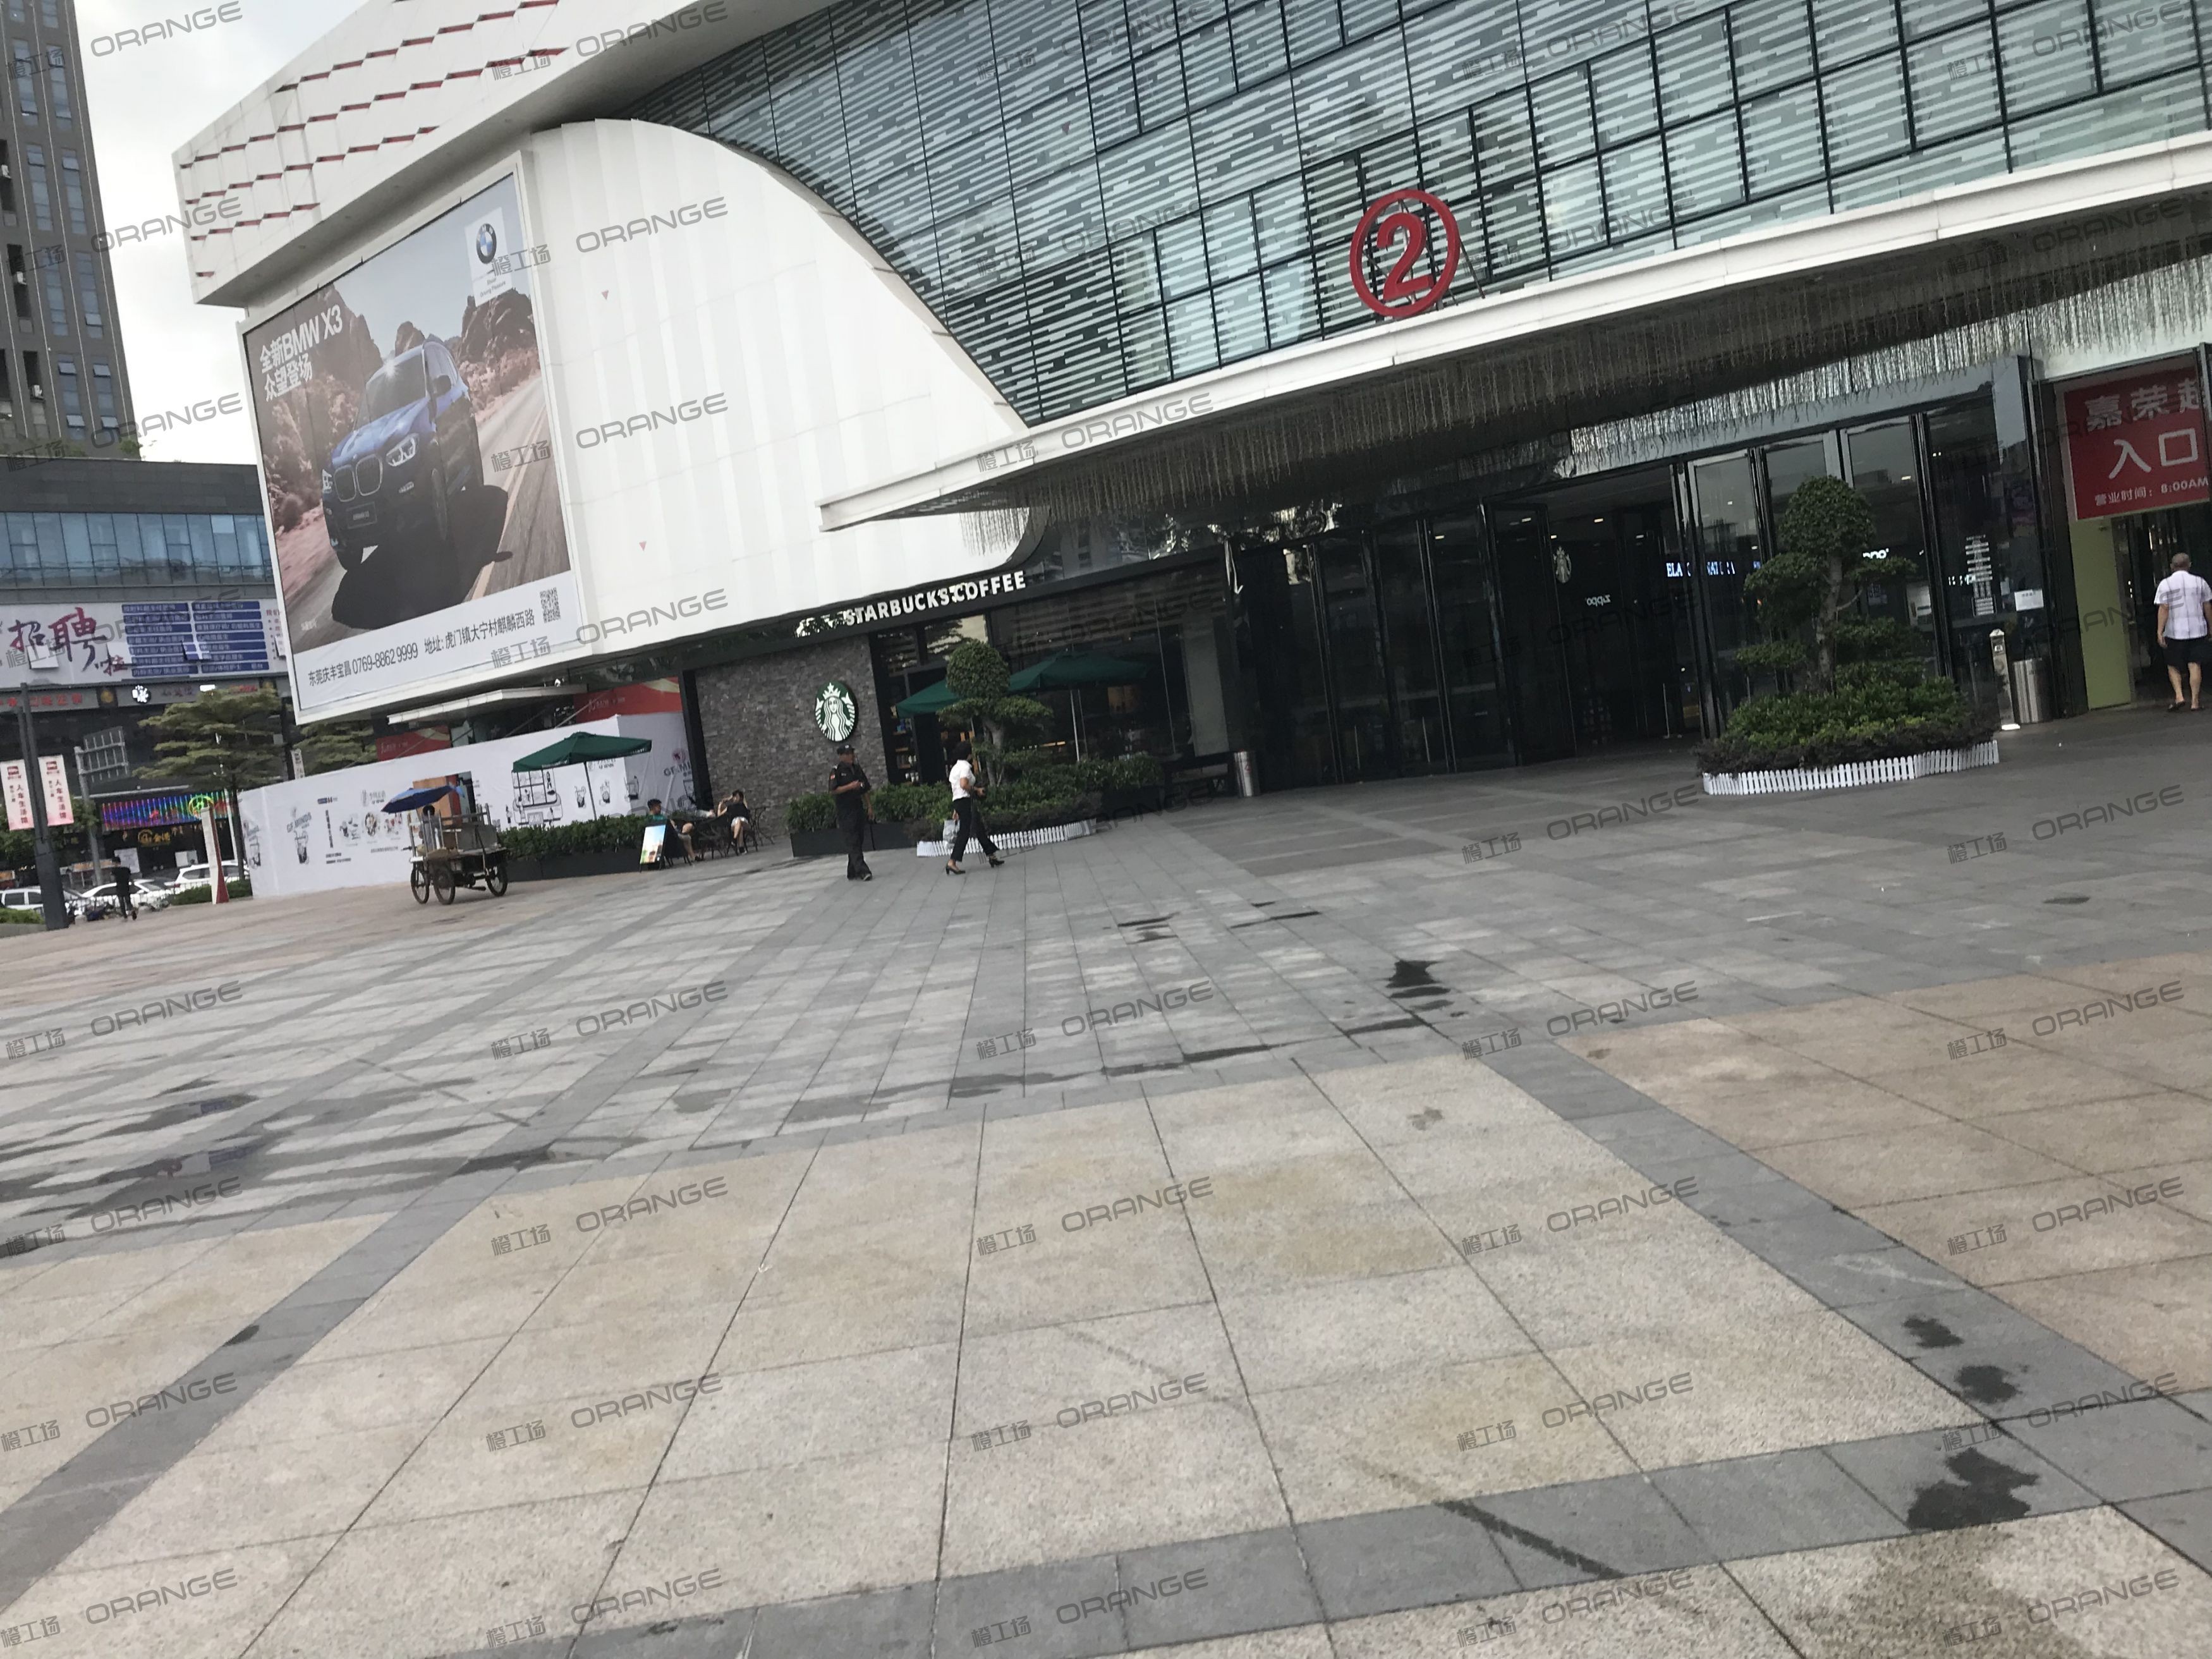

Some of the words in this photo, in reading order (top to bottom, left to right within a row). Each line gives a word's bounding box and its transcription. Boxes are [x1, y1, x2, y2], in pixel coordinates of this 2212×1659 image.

[260, 315, 320, 374] 全新BMW
[320, 305, 343, 339] X3
[264, 353, 312, 402] 众望登场
[2108, 427, 2199, 480] 入口
[845, 587, 950, 626] STARBUCKS
[952, 570, 1026, 603] COFFEE
[352, 648, 396, 674] 0769-8862
[396, 642, 418, 663] 9999
